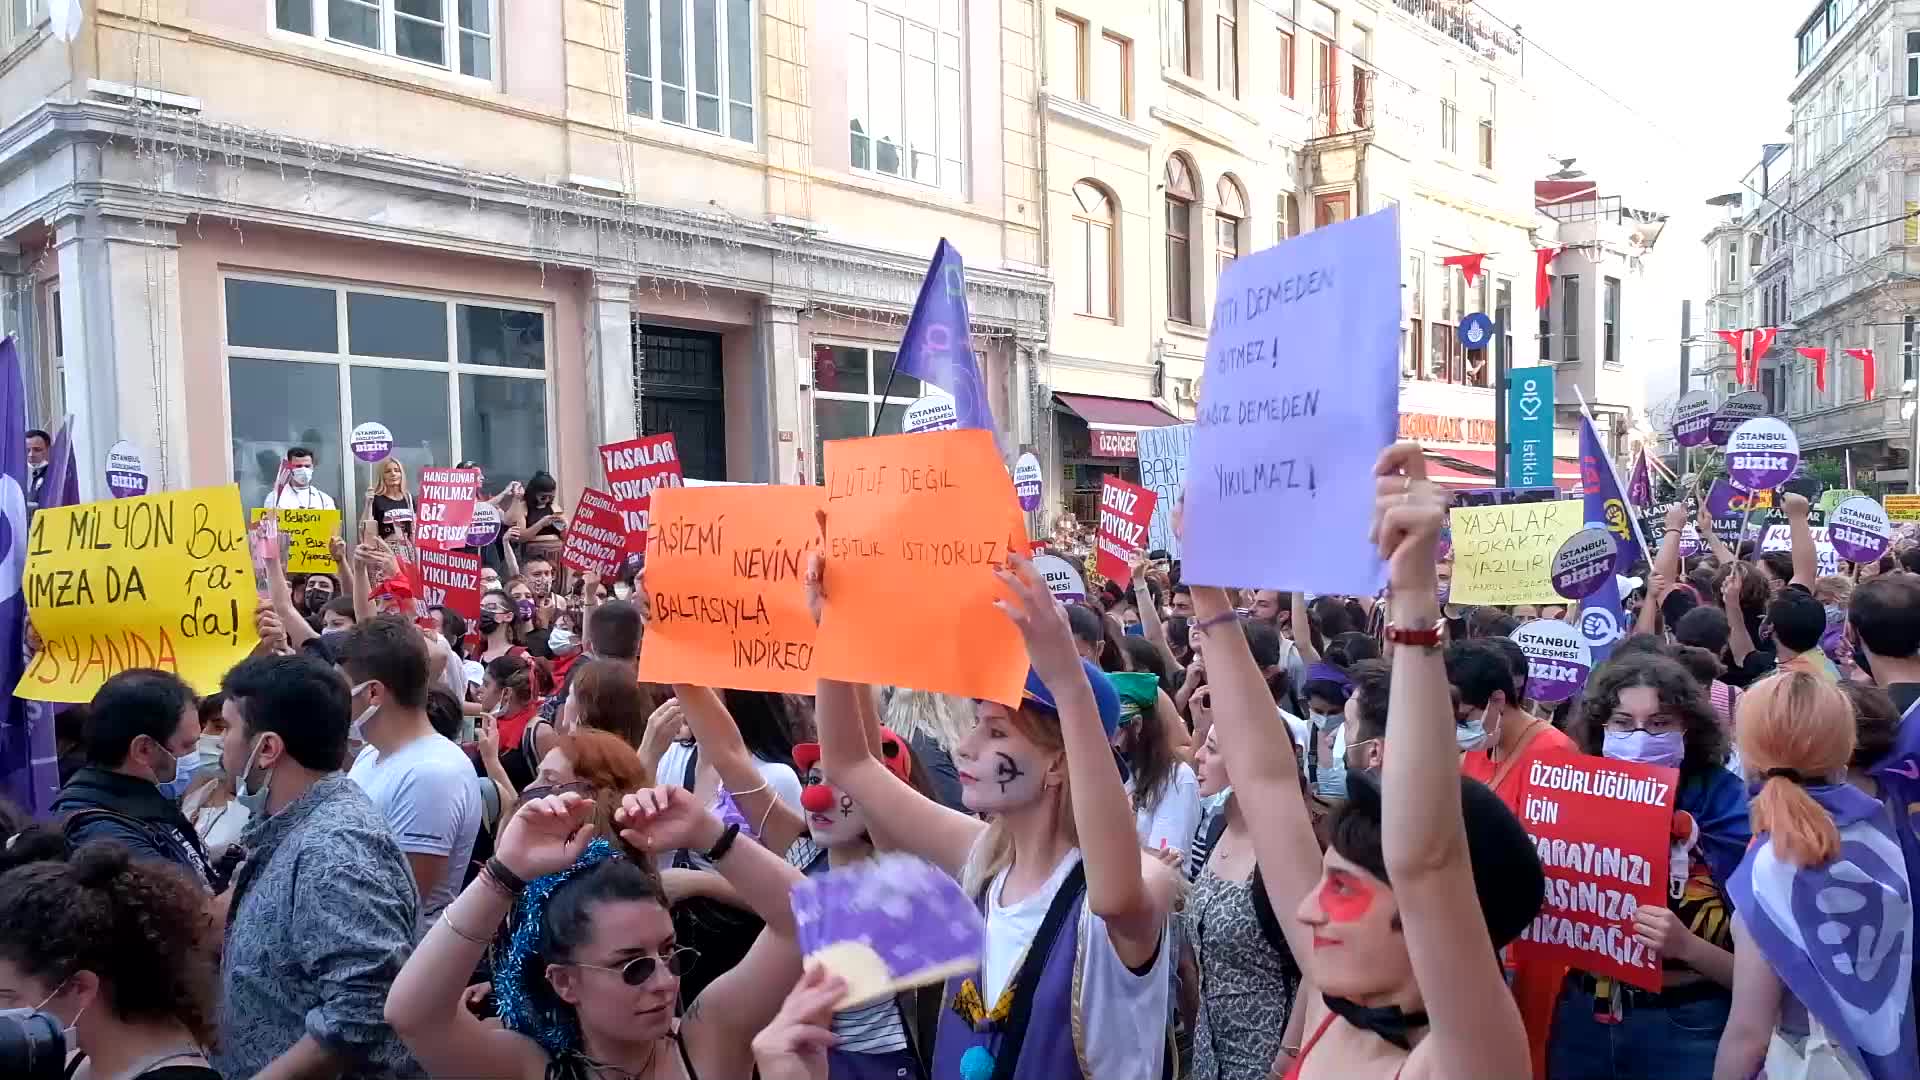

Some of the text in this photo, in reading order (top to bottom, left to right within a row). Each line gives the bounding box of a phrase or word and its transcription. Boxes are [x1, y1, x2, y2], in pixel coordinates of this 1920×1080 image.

[1246, 268, 1335, 320] DEMEDEN
[909, 404, 953, 419] İSTANBUL
[1238, 388, 1321, 424] DEMEDEN
[1678, 416, 1711, 435] BİZİM
[1736, 432, 1788, 441] İSTANBUL
[355, 440, 388, 453] BİZİM
[602, 440, 675, 473] YASALAR
[1736, 442, 1788, 451] SÖZLEŞMESİ
[1732, 452, 1789, 471] BİZİM
[111, 472, 144, 490] BİZİM
[423, 471, 475, 484] HANGİ DUVAR
[611, 471, 680, 502] SOKAKTA
[422, 485, 474, 501] YIKILMAZ
[1102, 482, 1138, 516] DENİZ
[420, 502, 447, 522] BİZ
[577, 504, 594, 520] İÇİN
[1460, 503, 1563, 536] YASALAR
[1838, 515, 1883, 533] SÖZLEŞMESİ
[1839, 506, 1884, 525] İSTANBUL
[30, 499, 174, 556] 1 MİLYON
[1100, 509, 1144, 547] POYRAZ
[1833, 526, 1882, 551] BİZİM
[566, 533, 617, 561] BAŞINIZA
[1559, 538, 1608, 561] İSTANBUL
[422, 550, 478, 571] HANGİ DUVAR
[1559, 558, 1610, 588] BİZİM
[28, 562, 147, 608] İMZA DA
[422, 566, 478, 591] YIKILMAZ
[423, 585, 447, 607] BİZ
[180, 596, 239, 646] da!
[655, 592, 770, 628] BALTASIYLA
[1518, 632, 1580, 649] İSTANBUL
[1520, 646, 1578, 659] ÖZLEŞMESİ
[1528, 658, 1578, 683] İZİM
[1529, 759, 1669, 808] ÖZGÜRLÜĞÜMÜZ
[1525, 793, 1559, 825] İÇİN
[1544, 876, 1638, 921] AŞINIZA
